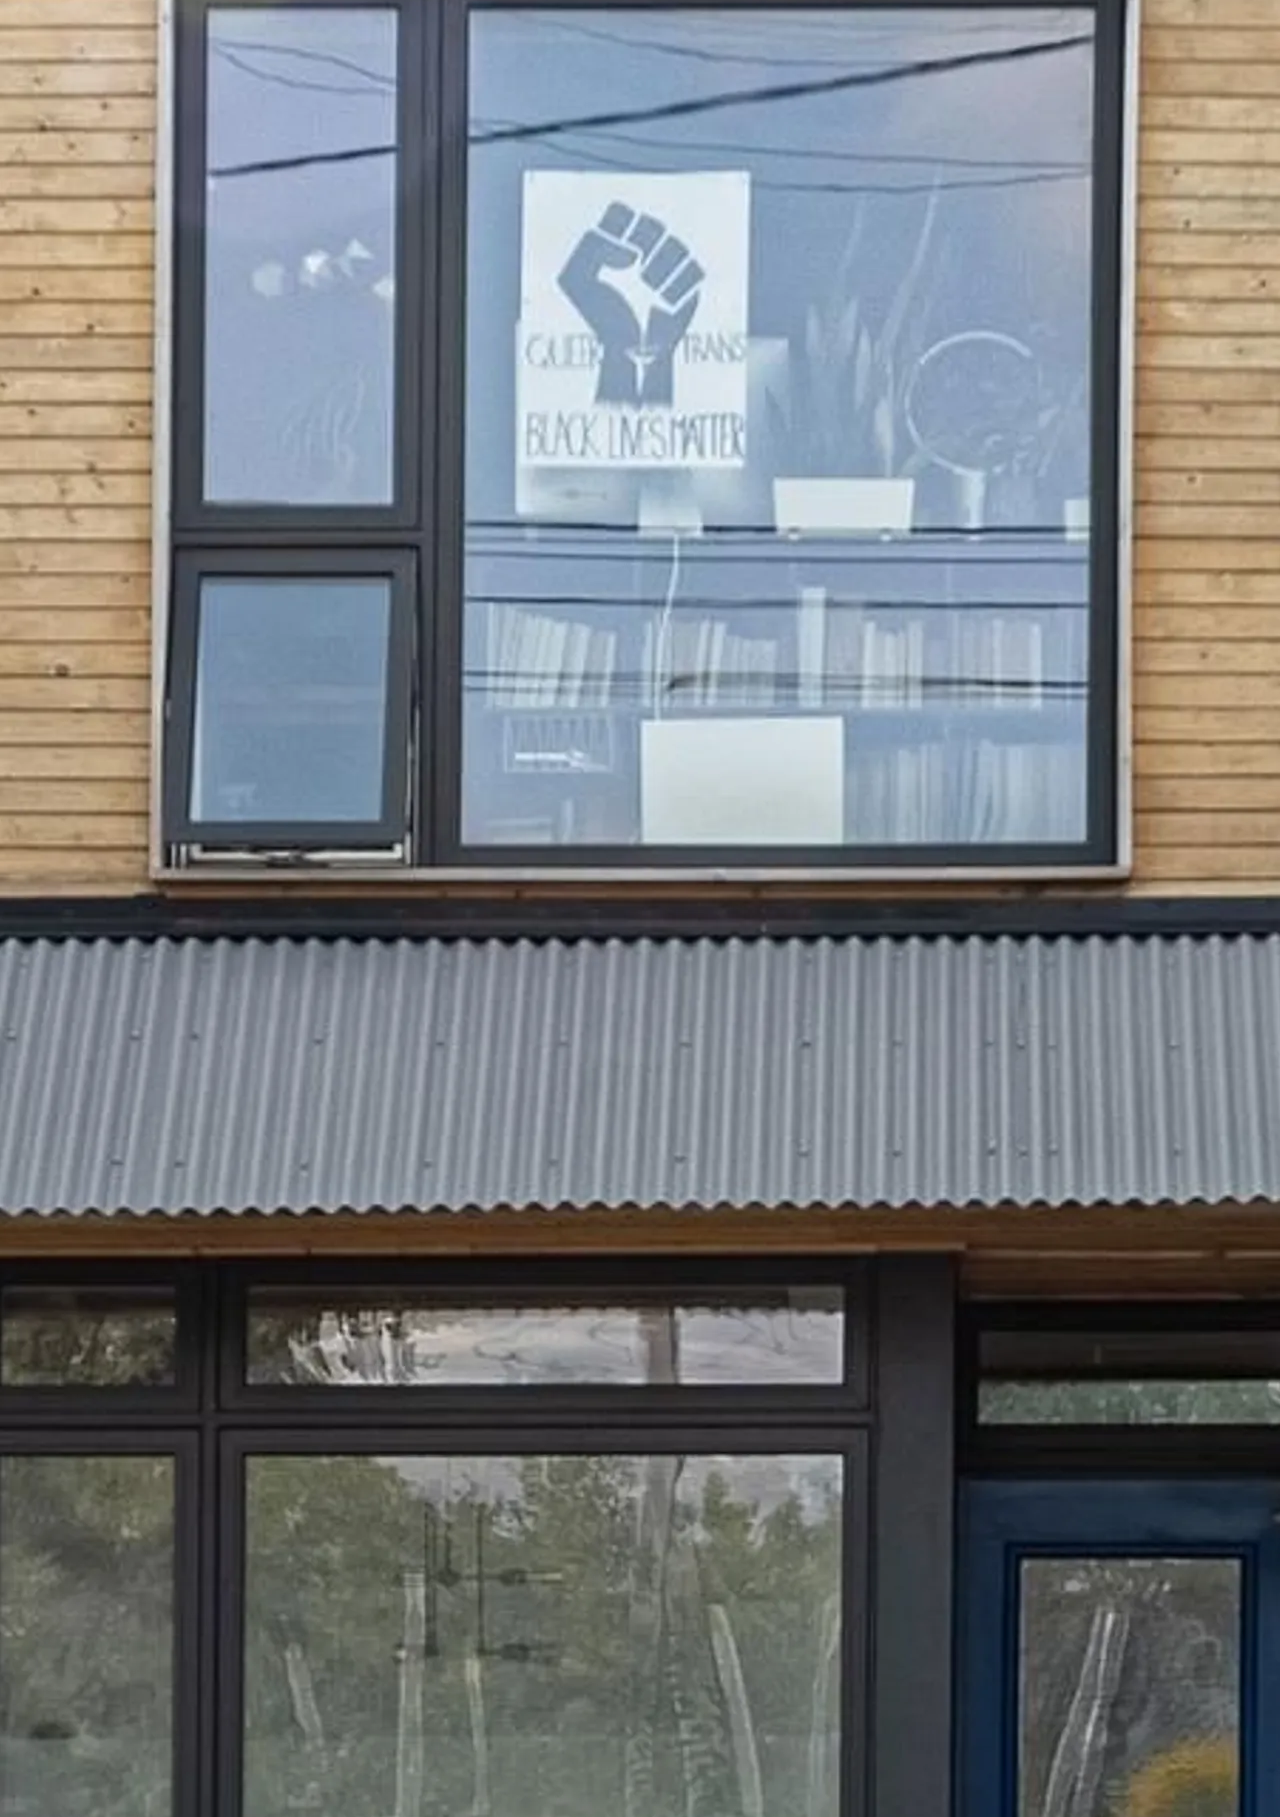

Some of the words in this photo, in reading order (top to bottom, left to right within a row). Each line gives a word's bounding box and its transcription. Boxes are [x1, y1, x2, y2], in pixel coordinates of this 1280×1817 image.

[683, 330, 747, 364] TRANS
[525, 410, 601, 458] BLACK
[608, 412, 667, 460] LIVES
[670, 411, 746, 461] MATTER
